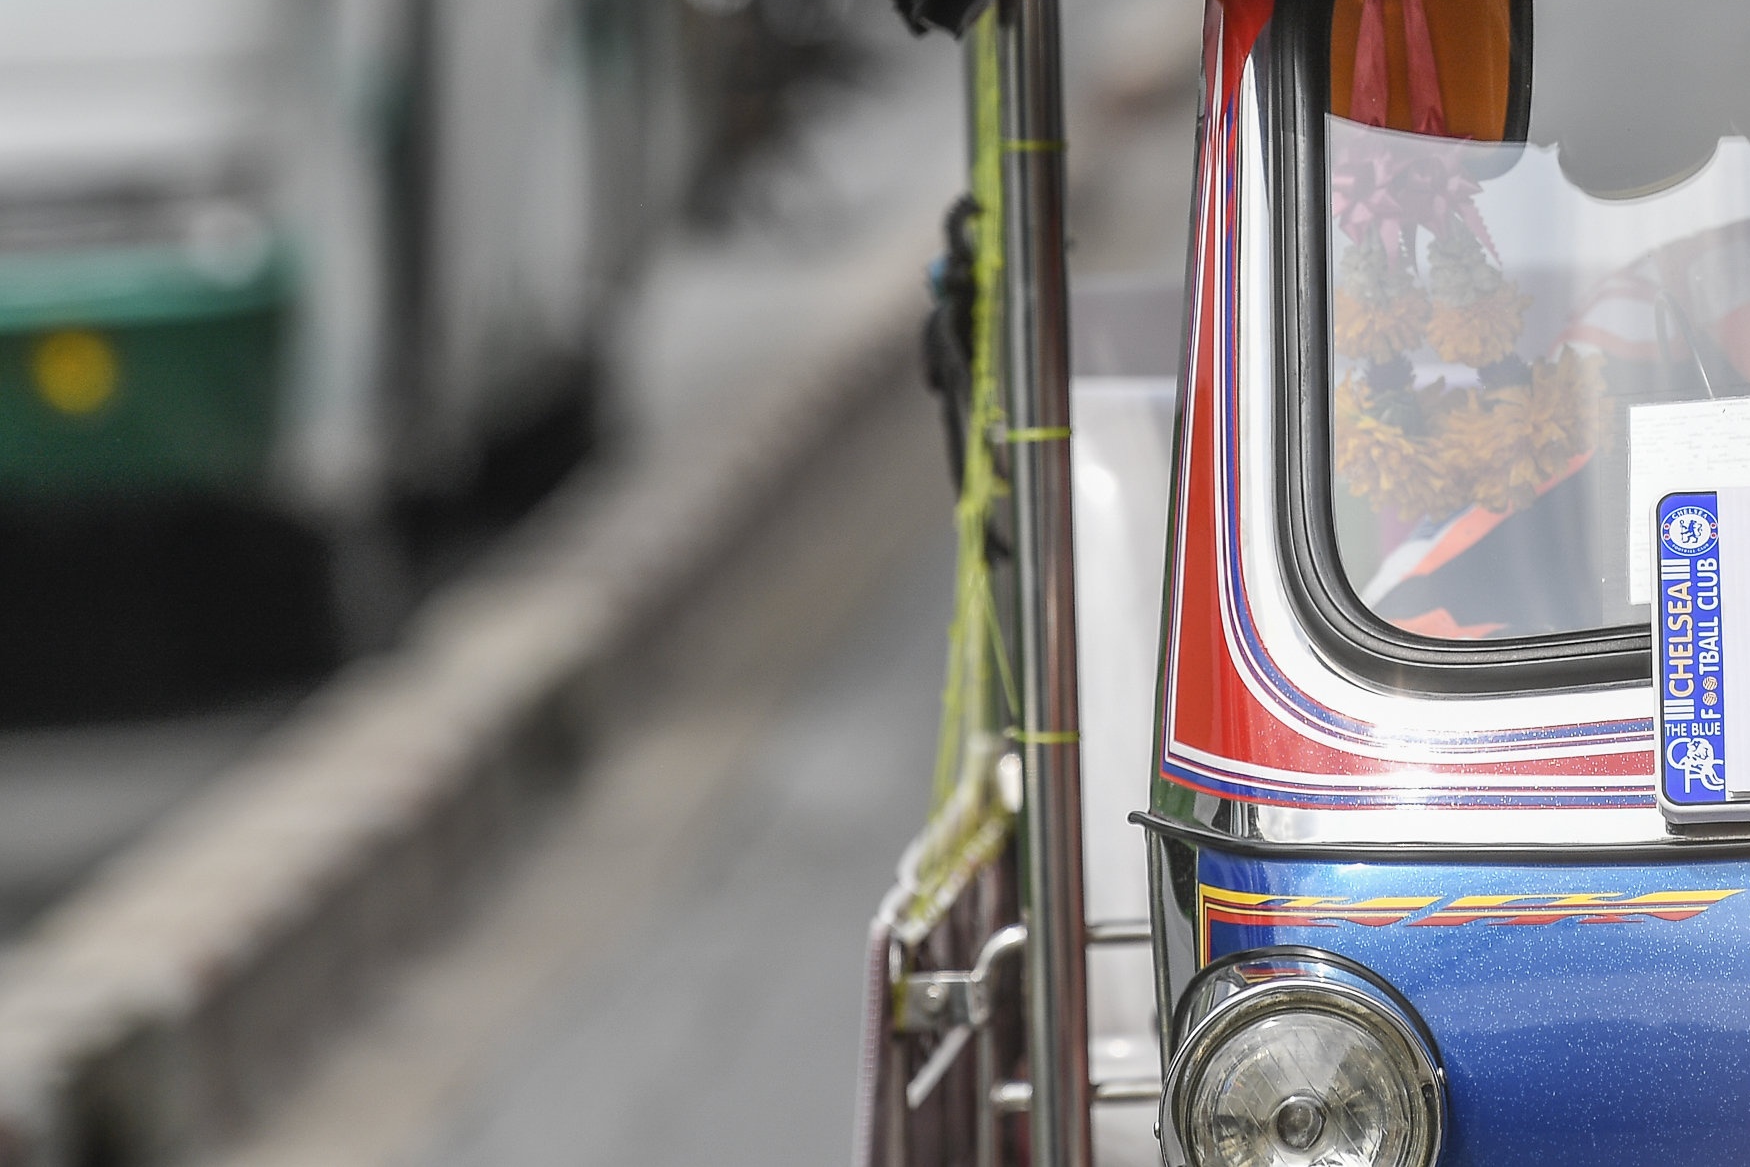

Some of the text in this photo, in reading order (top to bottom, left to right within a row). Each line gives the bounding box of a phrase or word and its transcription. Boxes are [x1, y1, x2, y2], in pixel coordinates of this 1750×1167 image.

[1671, 508, 1708, 519] CHELSEA
[1697, 557, 1719, 611] CLUB
[1667, 581, 1695, 698] CHELSEA
[1665, 721, 1721, 736] THE BLUE
